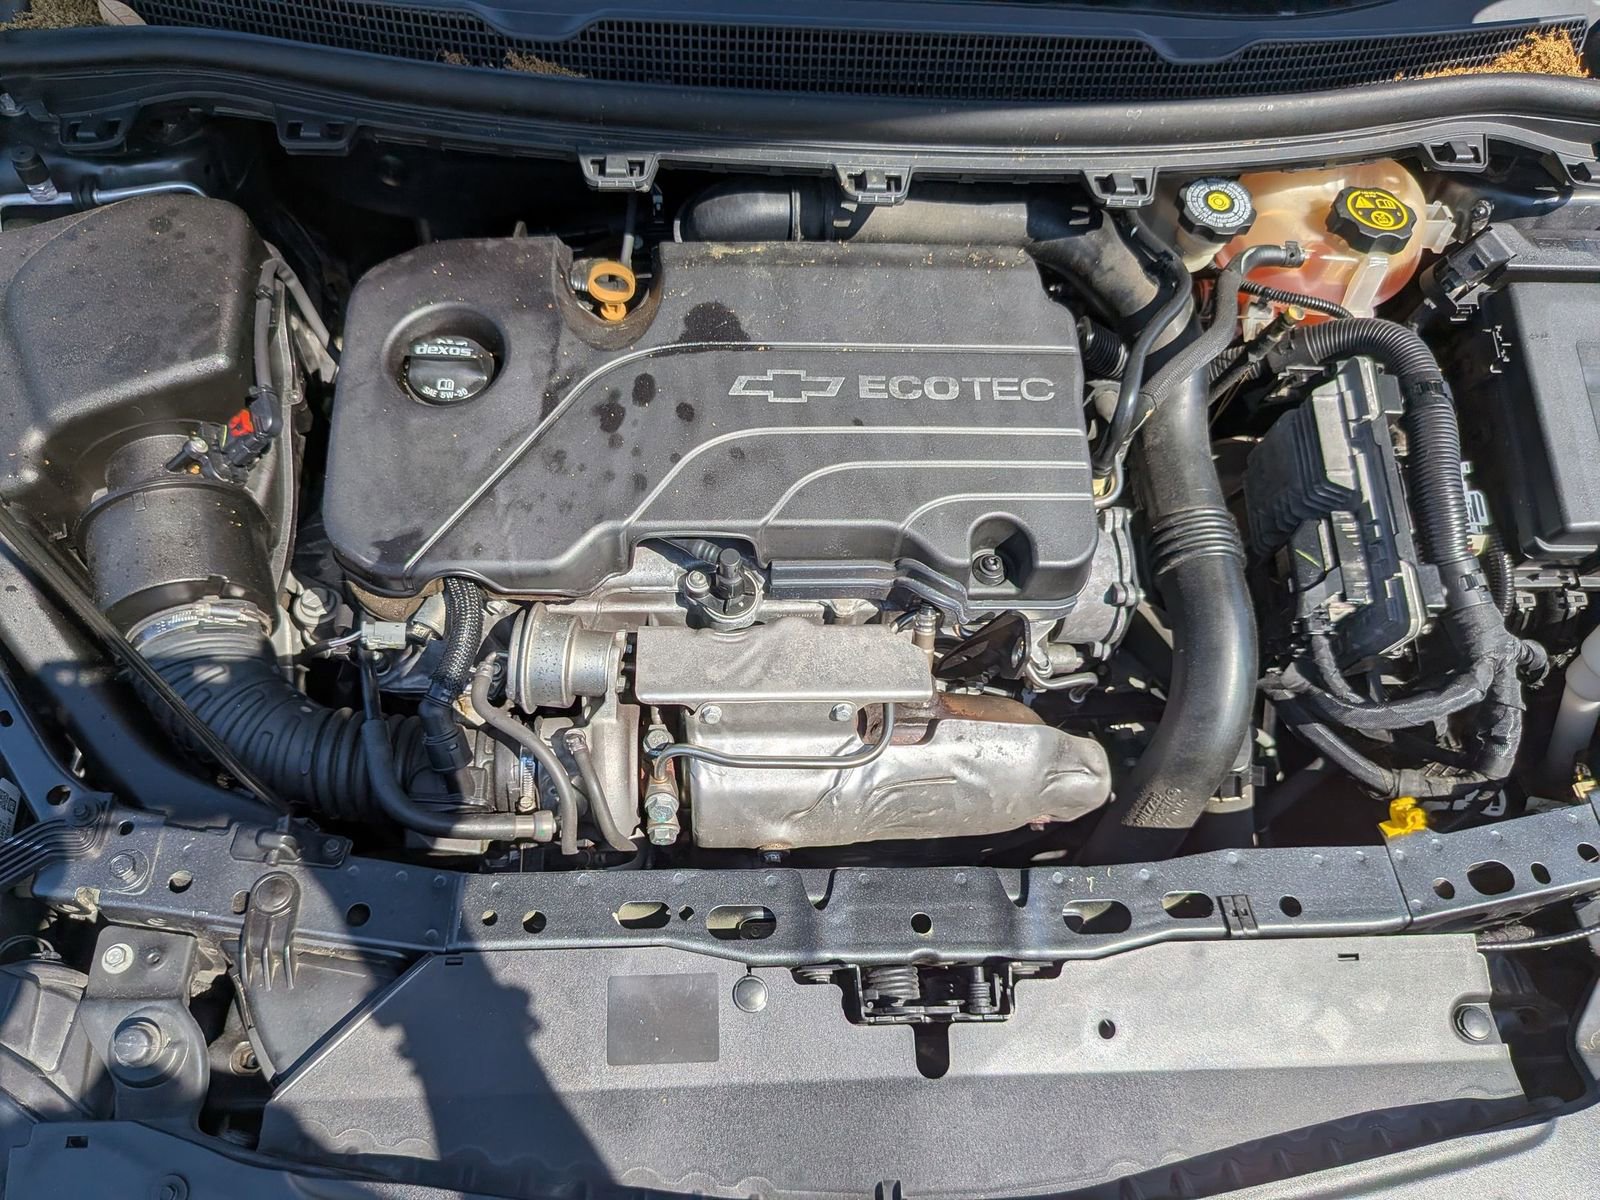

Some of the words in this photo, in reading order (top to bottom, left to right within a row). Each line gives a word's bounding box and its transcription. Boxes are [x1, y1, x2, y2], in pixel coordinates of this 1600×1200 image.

[415, 343, 474, 357] dexos
[421, 385, 439, 398] SAE
[439, 387, 469, 399] 5W-30
[858, 375, 1055, 401] ECOTEC
